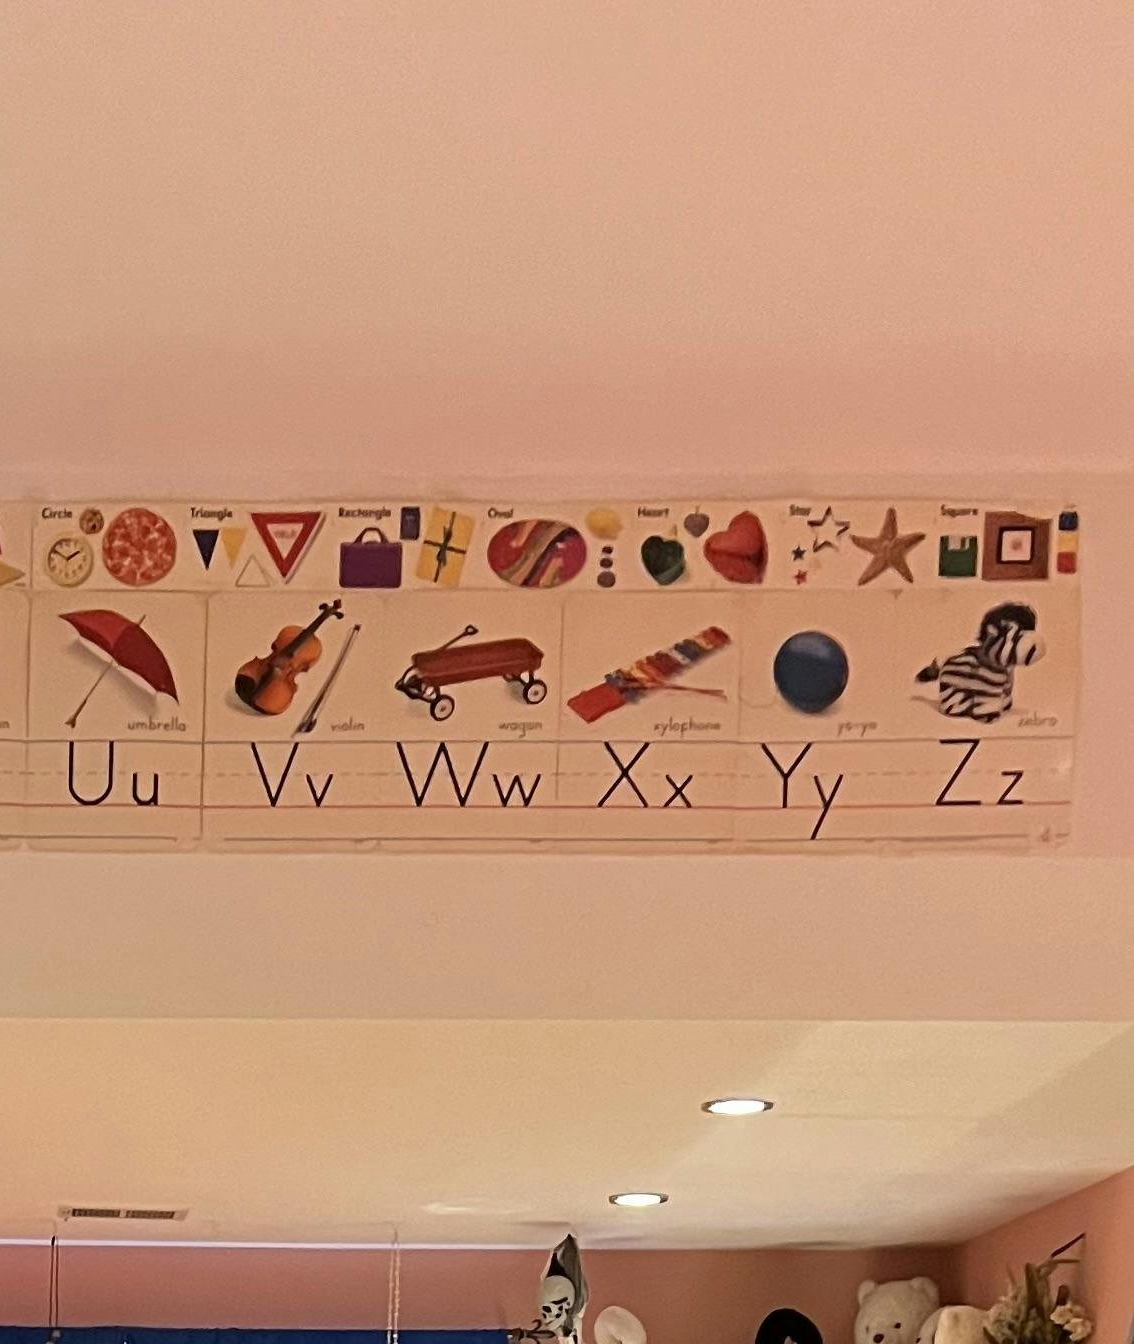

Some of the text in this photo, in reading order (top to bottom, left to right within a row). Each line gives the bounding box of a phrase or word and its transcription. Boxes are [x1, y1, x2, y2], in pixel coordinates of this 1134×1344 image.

[41, 507, 73, 520] Circle
[190, 507, 233, 520] Triangle
[338, 507, 391, 520] Rectangle
[488, 508, 514, 520] Oval
[637, 506, 669, 518] Heart
[789, 504, 811, 517] Star
[940, 505, 978, 518] Square
[127, 717, 187, 733] umbrella
[330, 718, 364, 732] violin
[498, 719, 543, 738] wagon
